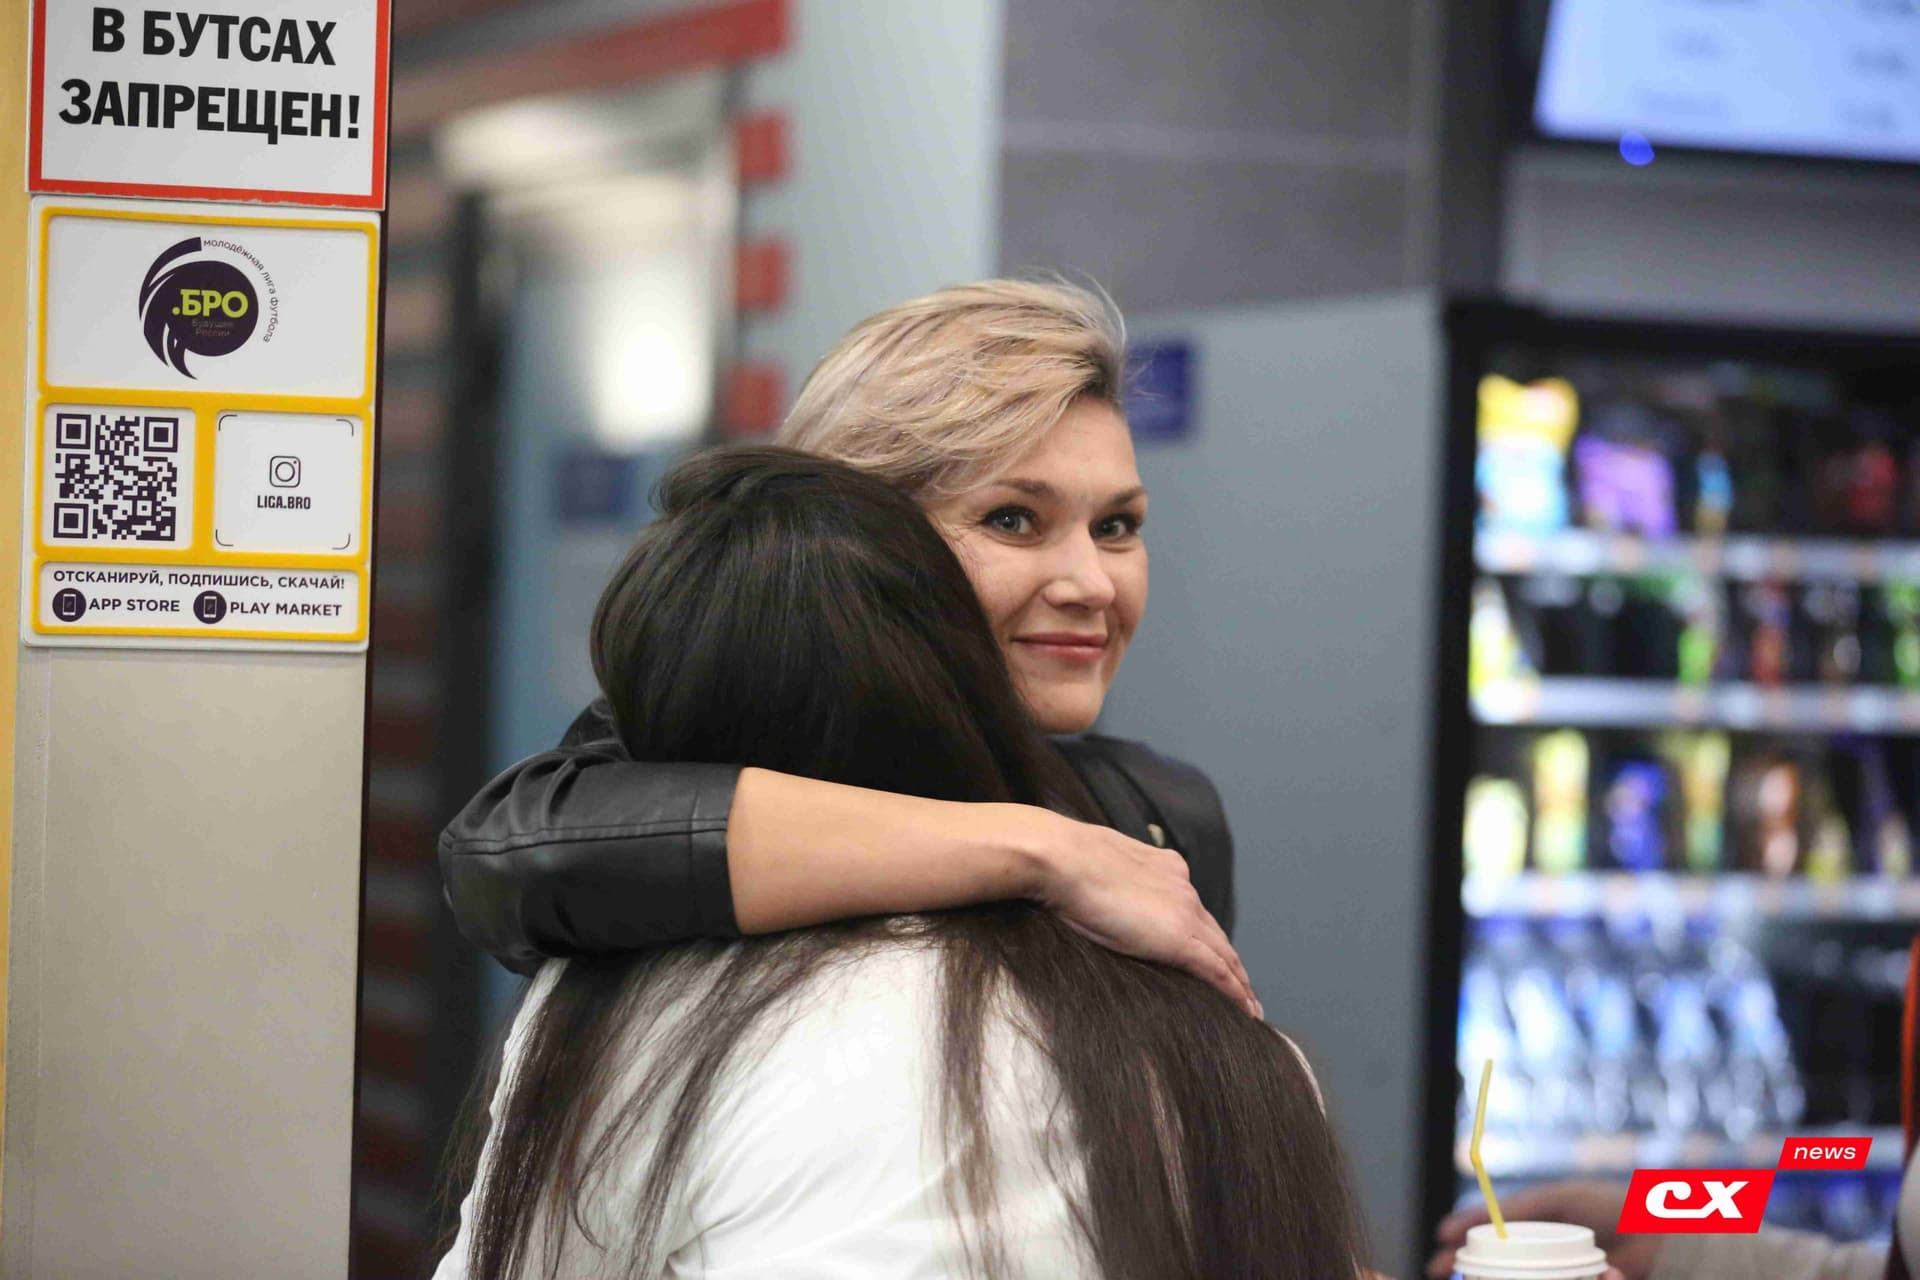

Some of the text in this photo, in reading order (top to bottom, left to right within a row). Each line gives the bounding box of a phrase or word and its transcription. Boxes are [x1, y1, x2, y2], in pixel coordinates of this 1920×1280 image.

[92, 7, 337, 66] В БУТСАХ
[58, 78, 360, 145] ЗАПРЕЩЕН!
[172, 288, 249, 318] .БРО
[257, 494, 311, 510] LIGA.BRO
[53, 569, 345, 589] ОТСКАНИРУЙ, ПОДПИШИСЬ, СКАЧАЙ!
[89, 599, 180, 612] APP STORE
[230, 602, 342, 617] PLAY MARKET
